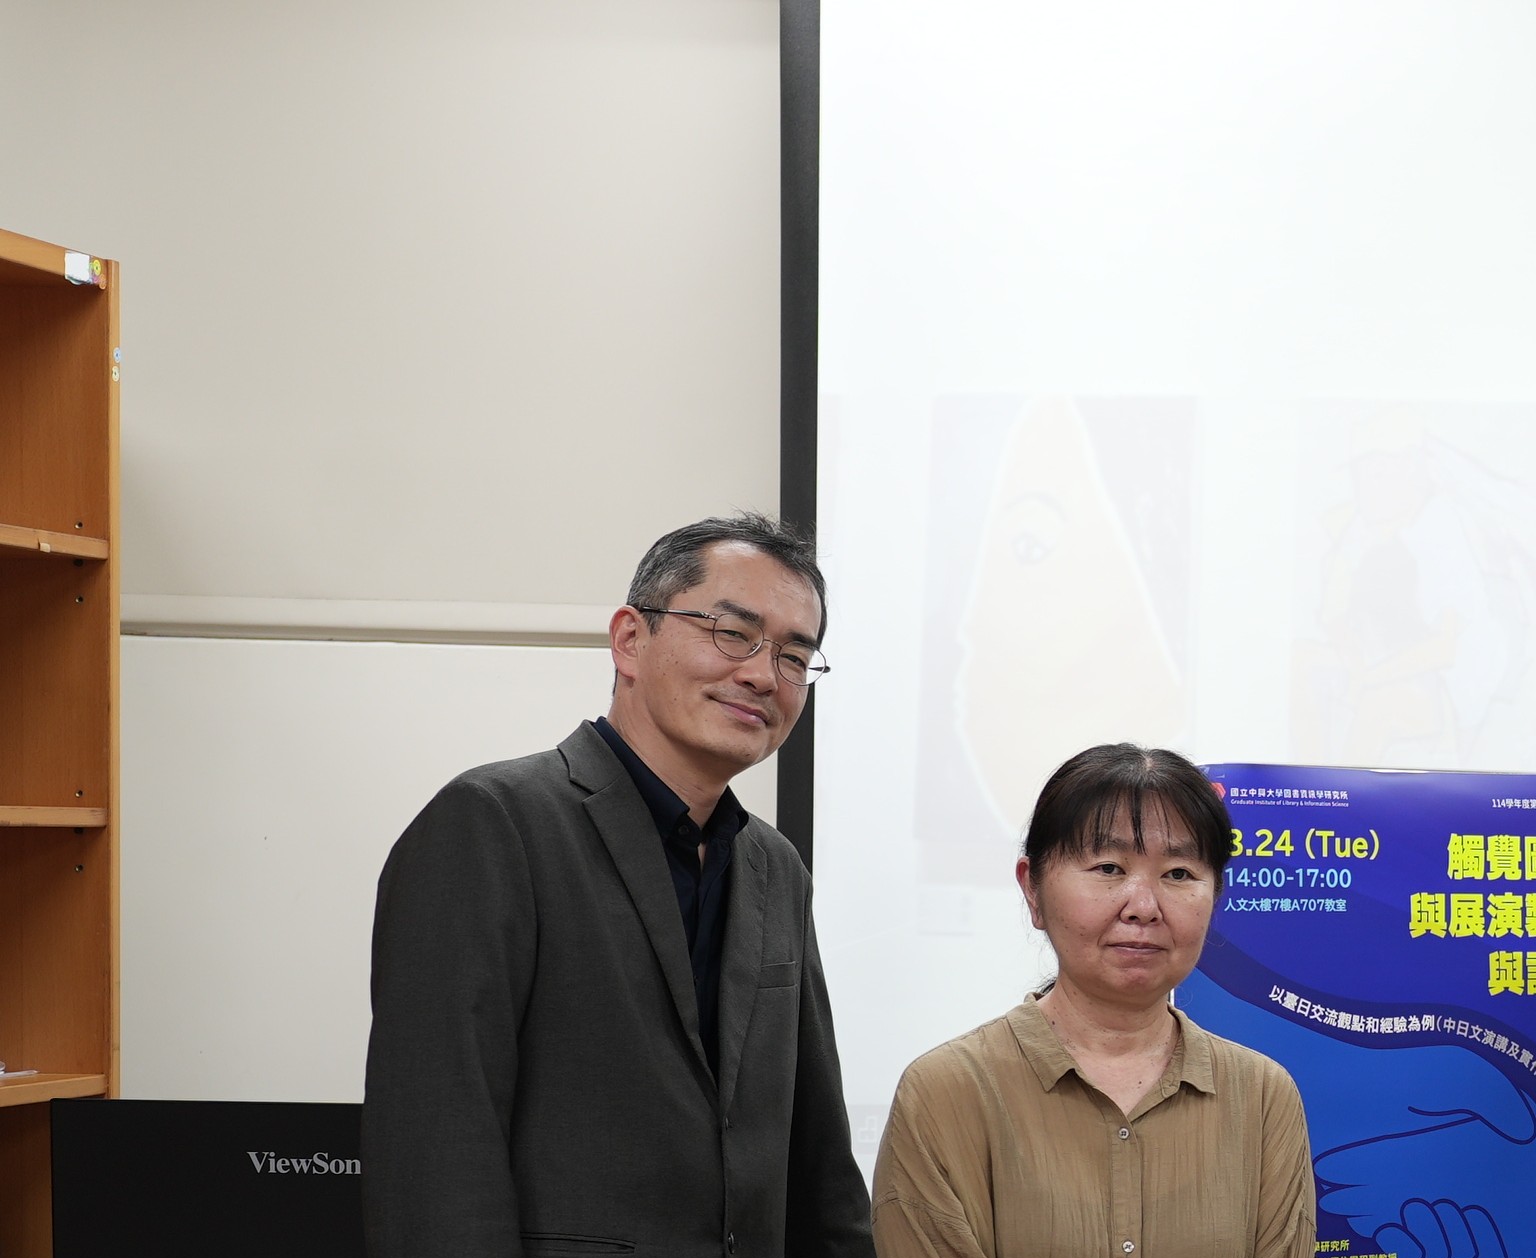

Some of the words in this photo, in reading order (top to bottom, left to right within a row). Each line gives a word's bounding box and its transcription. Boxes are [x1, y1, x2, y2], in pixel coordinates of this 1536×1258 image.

[1230, 787, 1348, 800] 國立中興大學圖書資訊學研究所
[1282, 800, 1299, 808] Library
[1305, 828, 1380, 860] (Tue)
[1225, 867, 1352, 889] 14:00-17:00
[1224, 898, 1347, 912] 人文大樓7樓A707教室
